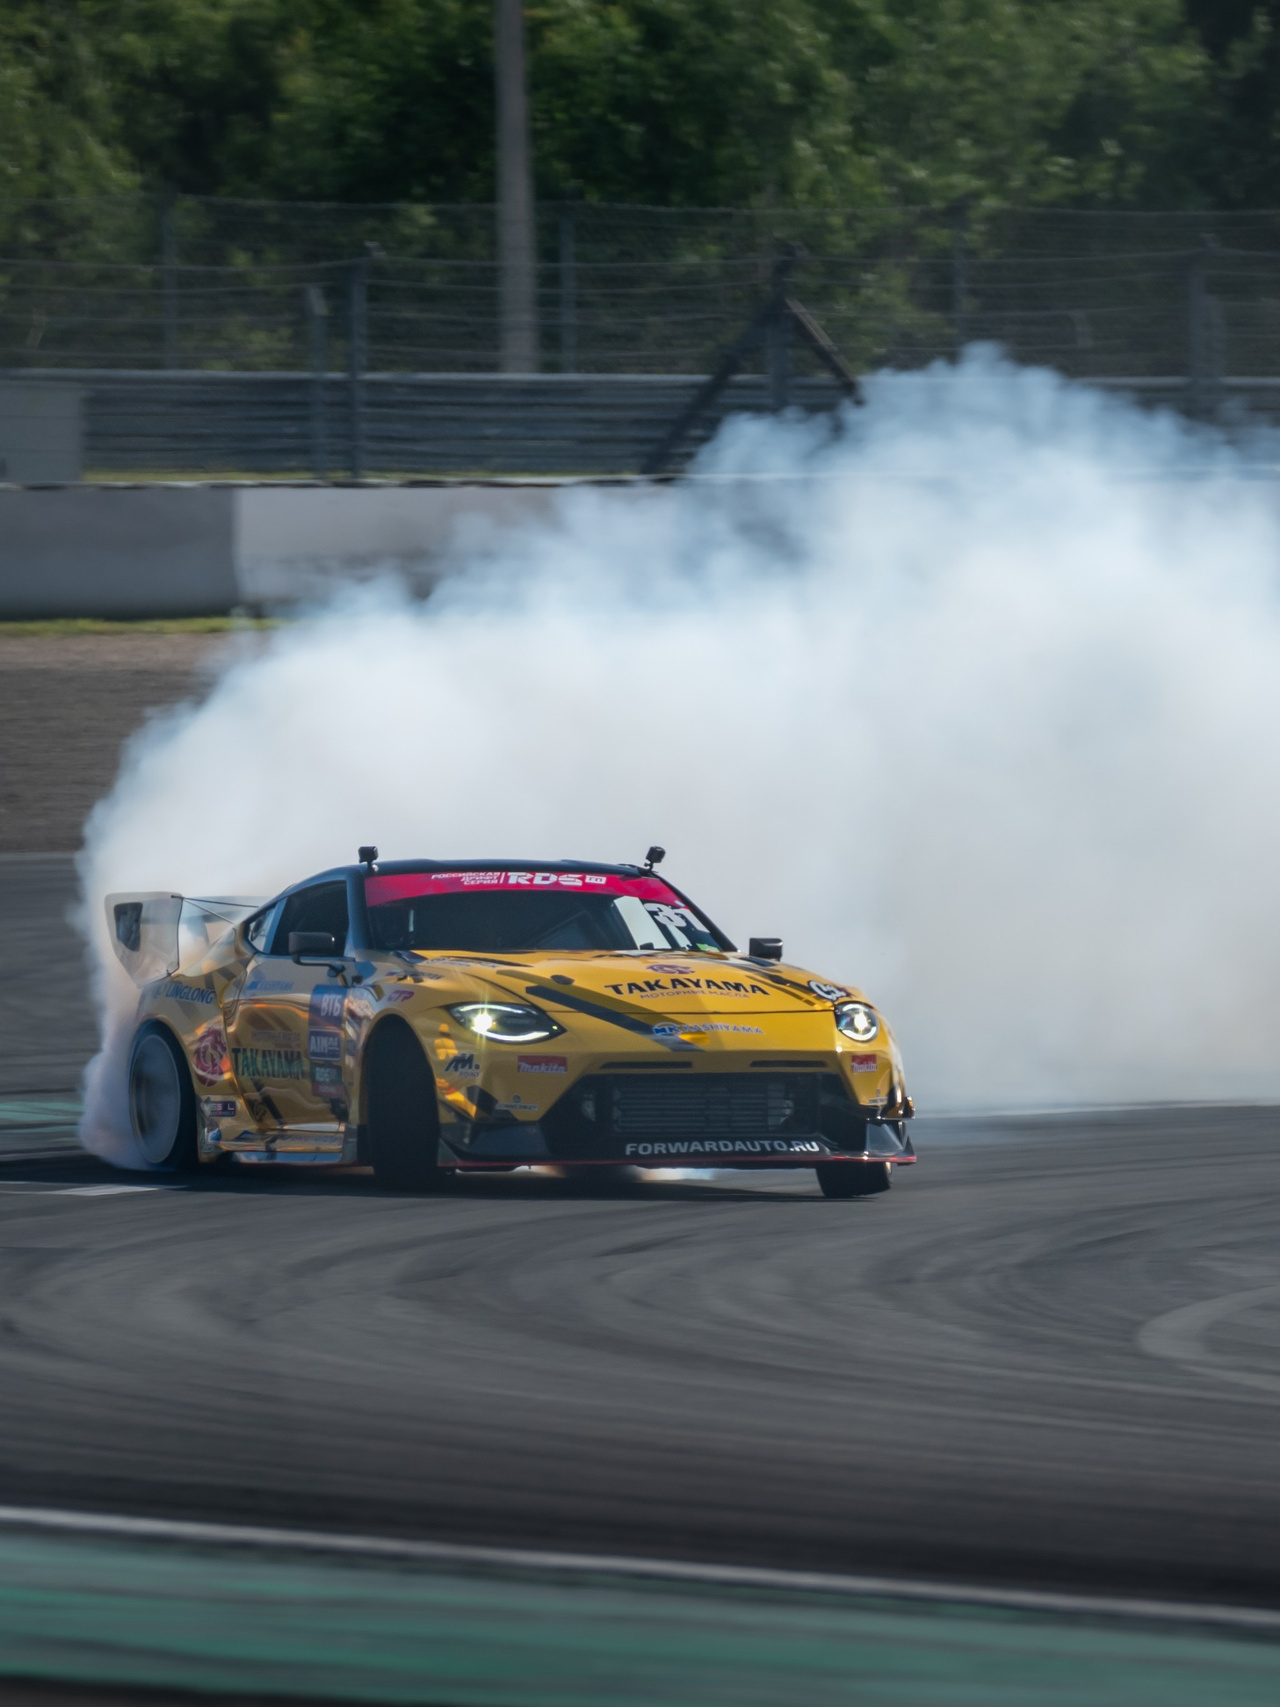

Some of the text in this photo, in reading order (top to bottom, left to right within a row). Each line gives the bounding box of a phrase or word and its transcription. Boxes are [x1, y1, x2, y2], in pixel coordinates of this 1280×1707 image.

[507, 872, 583, 886] RDS
[643, 903, 711, 933] 31
[165, 983, 216, 1004] LINGLONG
[604, 978, 770, 996] TAKAYAMA
[640, 990, 750, 999] МОТОРНЫЕ МАСЛА
[681, 1023, 767, 1035] KASHIYAMA
[231, 1047, 305, 1080] TAKAYAMA
[518, 1062, 566, 1073] makita
[625, 1140, 820, 1156] FORWARDAUTO.RU
